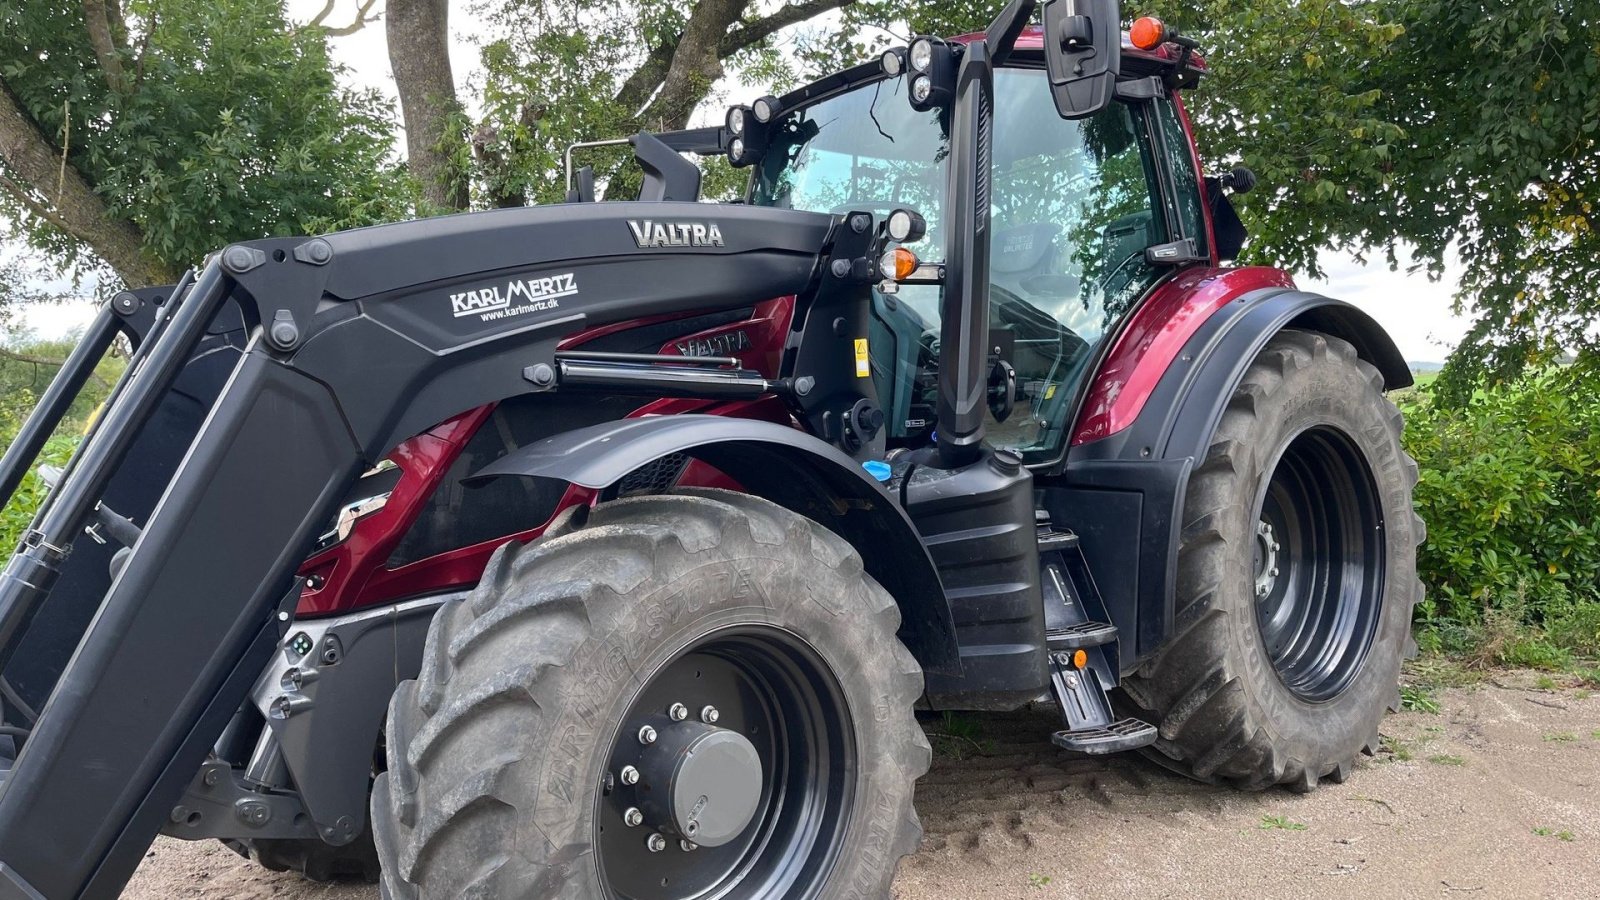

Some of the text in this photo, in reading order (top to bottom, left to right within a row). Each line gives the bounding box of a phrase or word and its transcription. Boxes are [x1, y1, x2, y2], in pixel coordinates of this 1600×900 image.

[626, 220, 725, 248] VALTRA
[480, 299, 559, 322] www.karlmertz.dk
[676, 331, 753, 357] VALTRA
[850, 788, 896, 900] BRID
